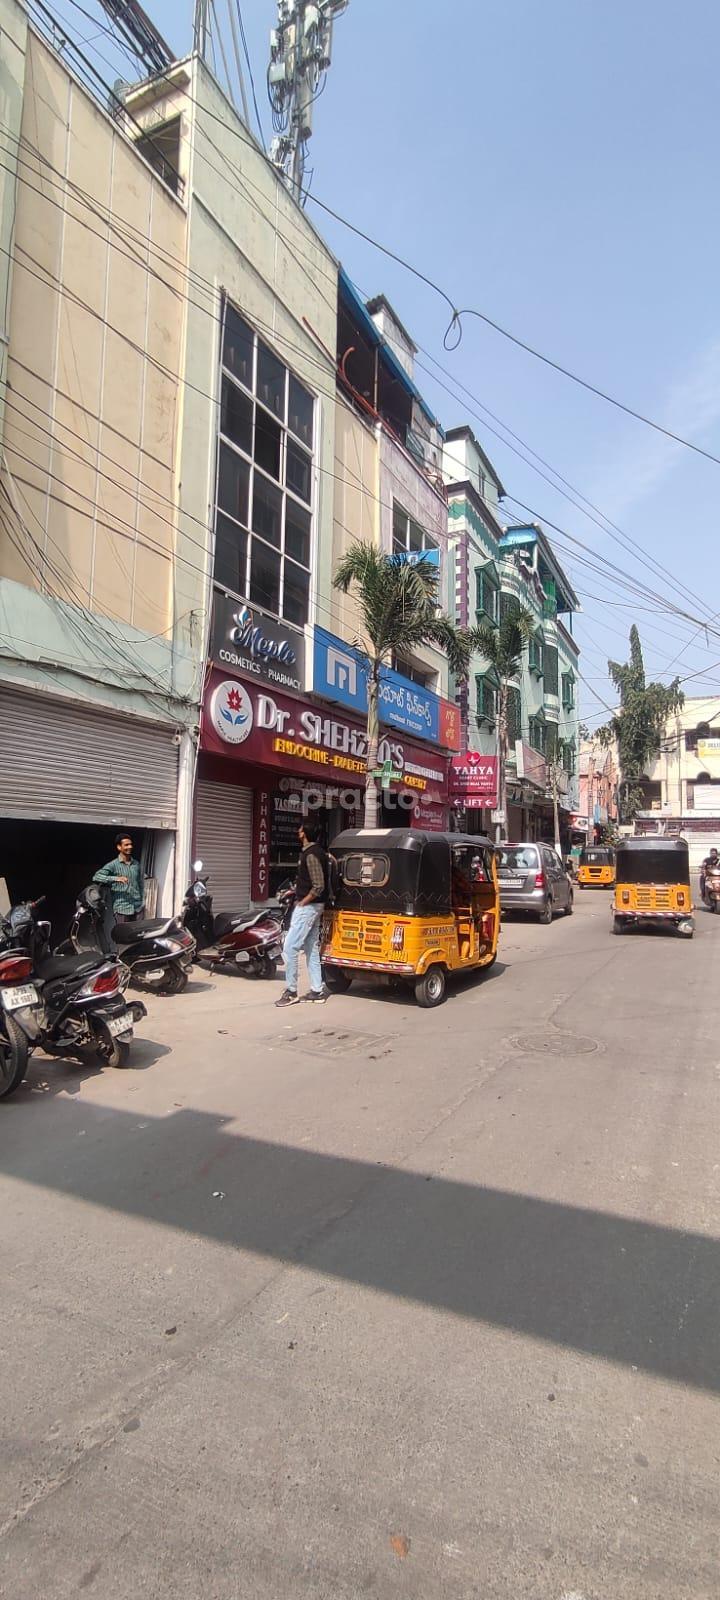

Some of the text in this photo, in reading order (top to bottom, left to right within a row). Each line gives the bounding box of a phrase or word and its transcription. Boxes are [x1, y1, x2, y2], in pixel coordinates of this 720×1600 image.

[219, 649, 261, 674] COSMETICS
[268, 668, 301, 690] PHARMACY
[257, 694, 404, 769] Dr. SHEHZD'S
[453, 766, 494, 775] YAHYA
[258, 792, 268, 893] PHARMACY
